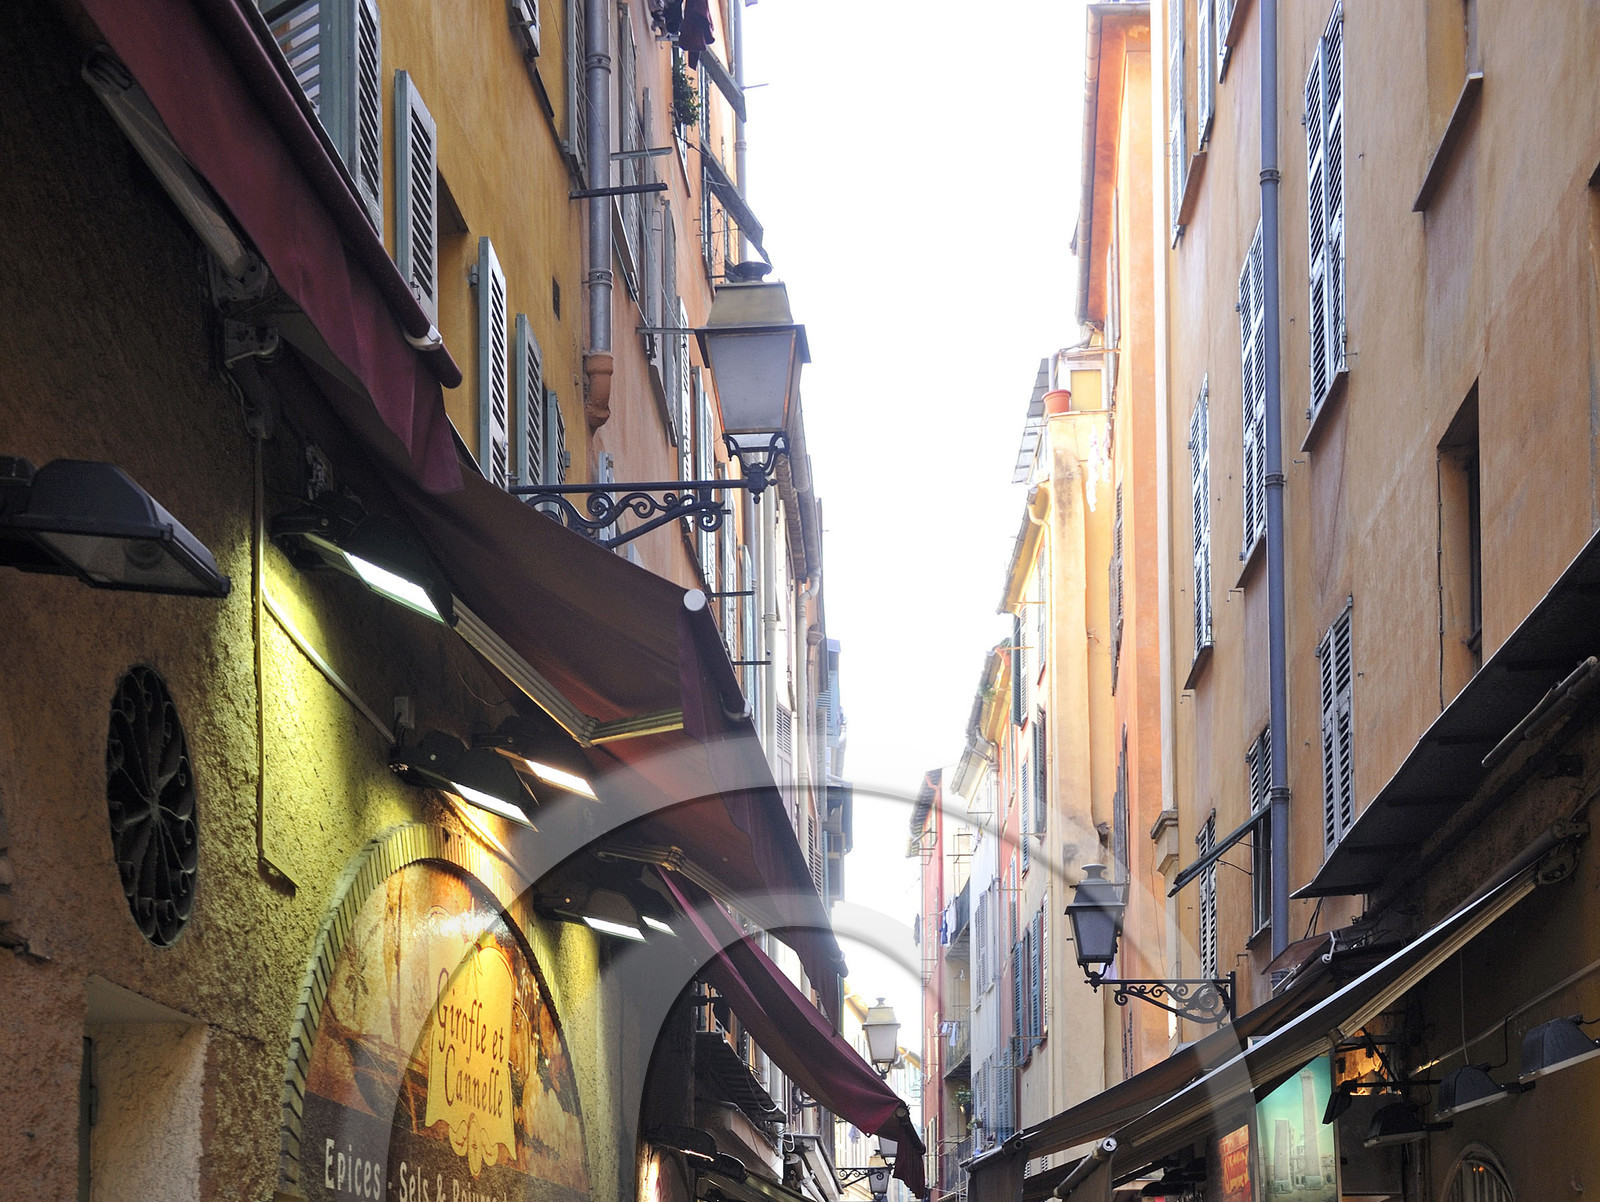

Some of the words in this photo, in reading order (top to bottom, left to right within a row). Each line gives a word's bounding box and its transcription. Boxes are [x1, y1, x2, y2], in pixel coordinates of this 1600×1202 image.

[437, 967, 487, 1064] Girofle
[492, 1027, 504, 1063] et
[444, 1044, 503, 1119] Cannelle
[325, 1138, 380, 1200] Epices
